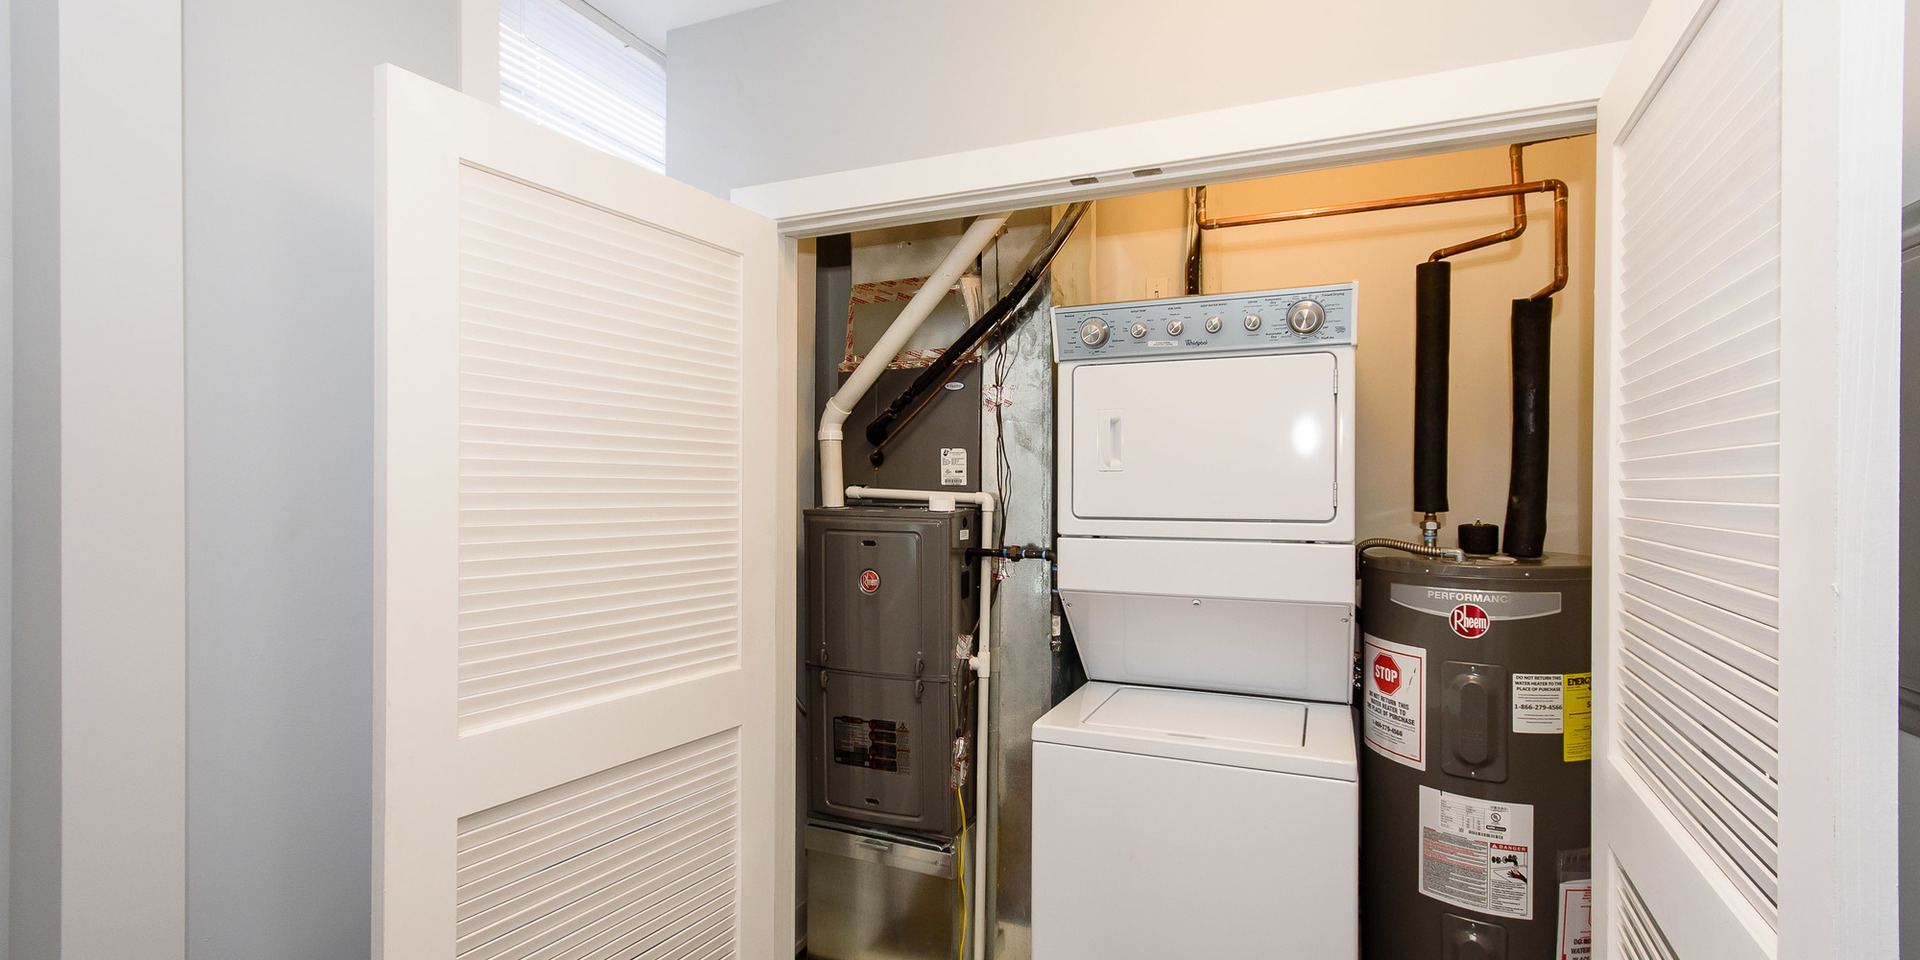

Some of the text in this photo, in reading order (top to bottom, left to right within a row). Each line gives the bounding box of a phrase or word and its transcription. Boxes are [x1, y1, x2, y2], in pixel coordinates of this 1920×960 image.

[1185, 339, 1207, 347] Whirlpool
[1454, 605, 1487, 633] Rheem
[1375, 664, 1398, 683] STOP
[1381, 696, 1396, 706] RETURN
[1398, 702, 1409, 710] THIS
[1382, 703, 1398, 714] HEATER
[1389, 713, 1415, 726] PURCHASE
